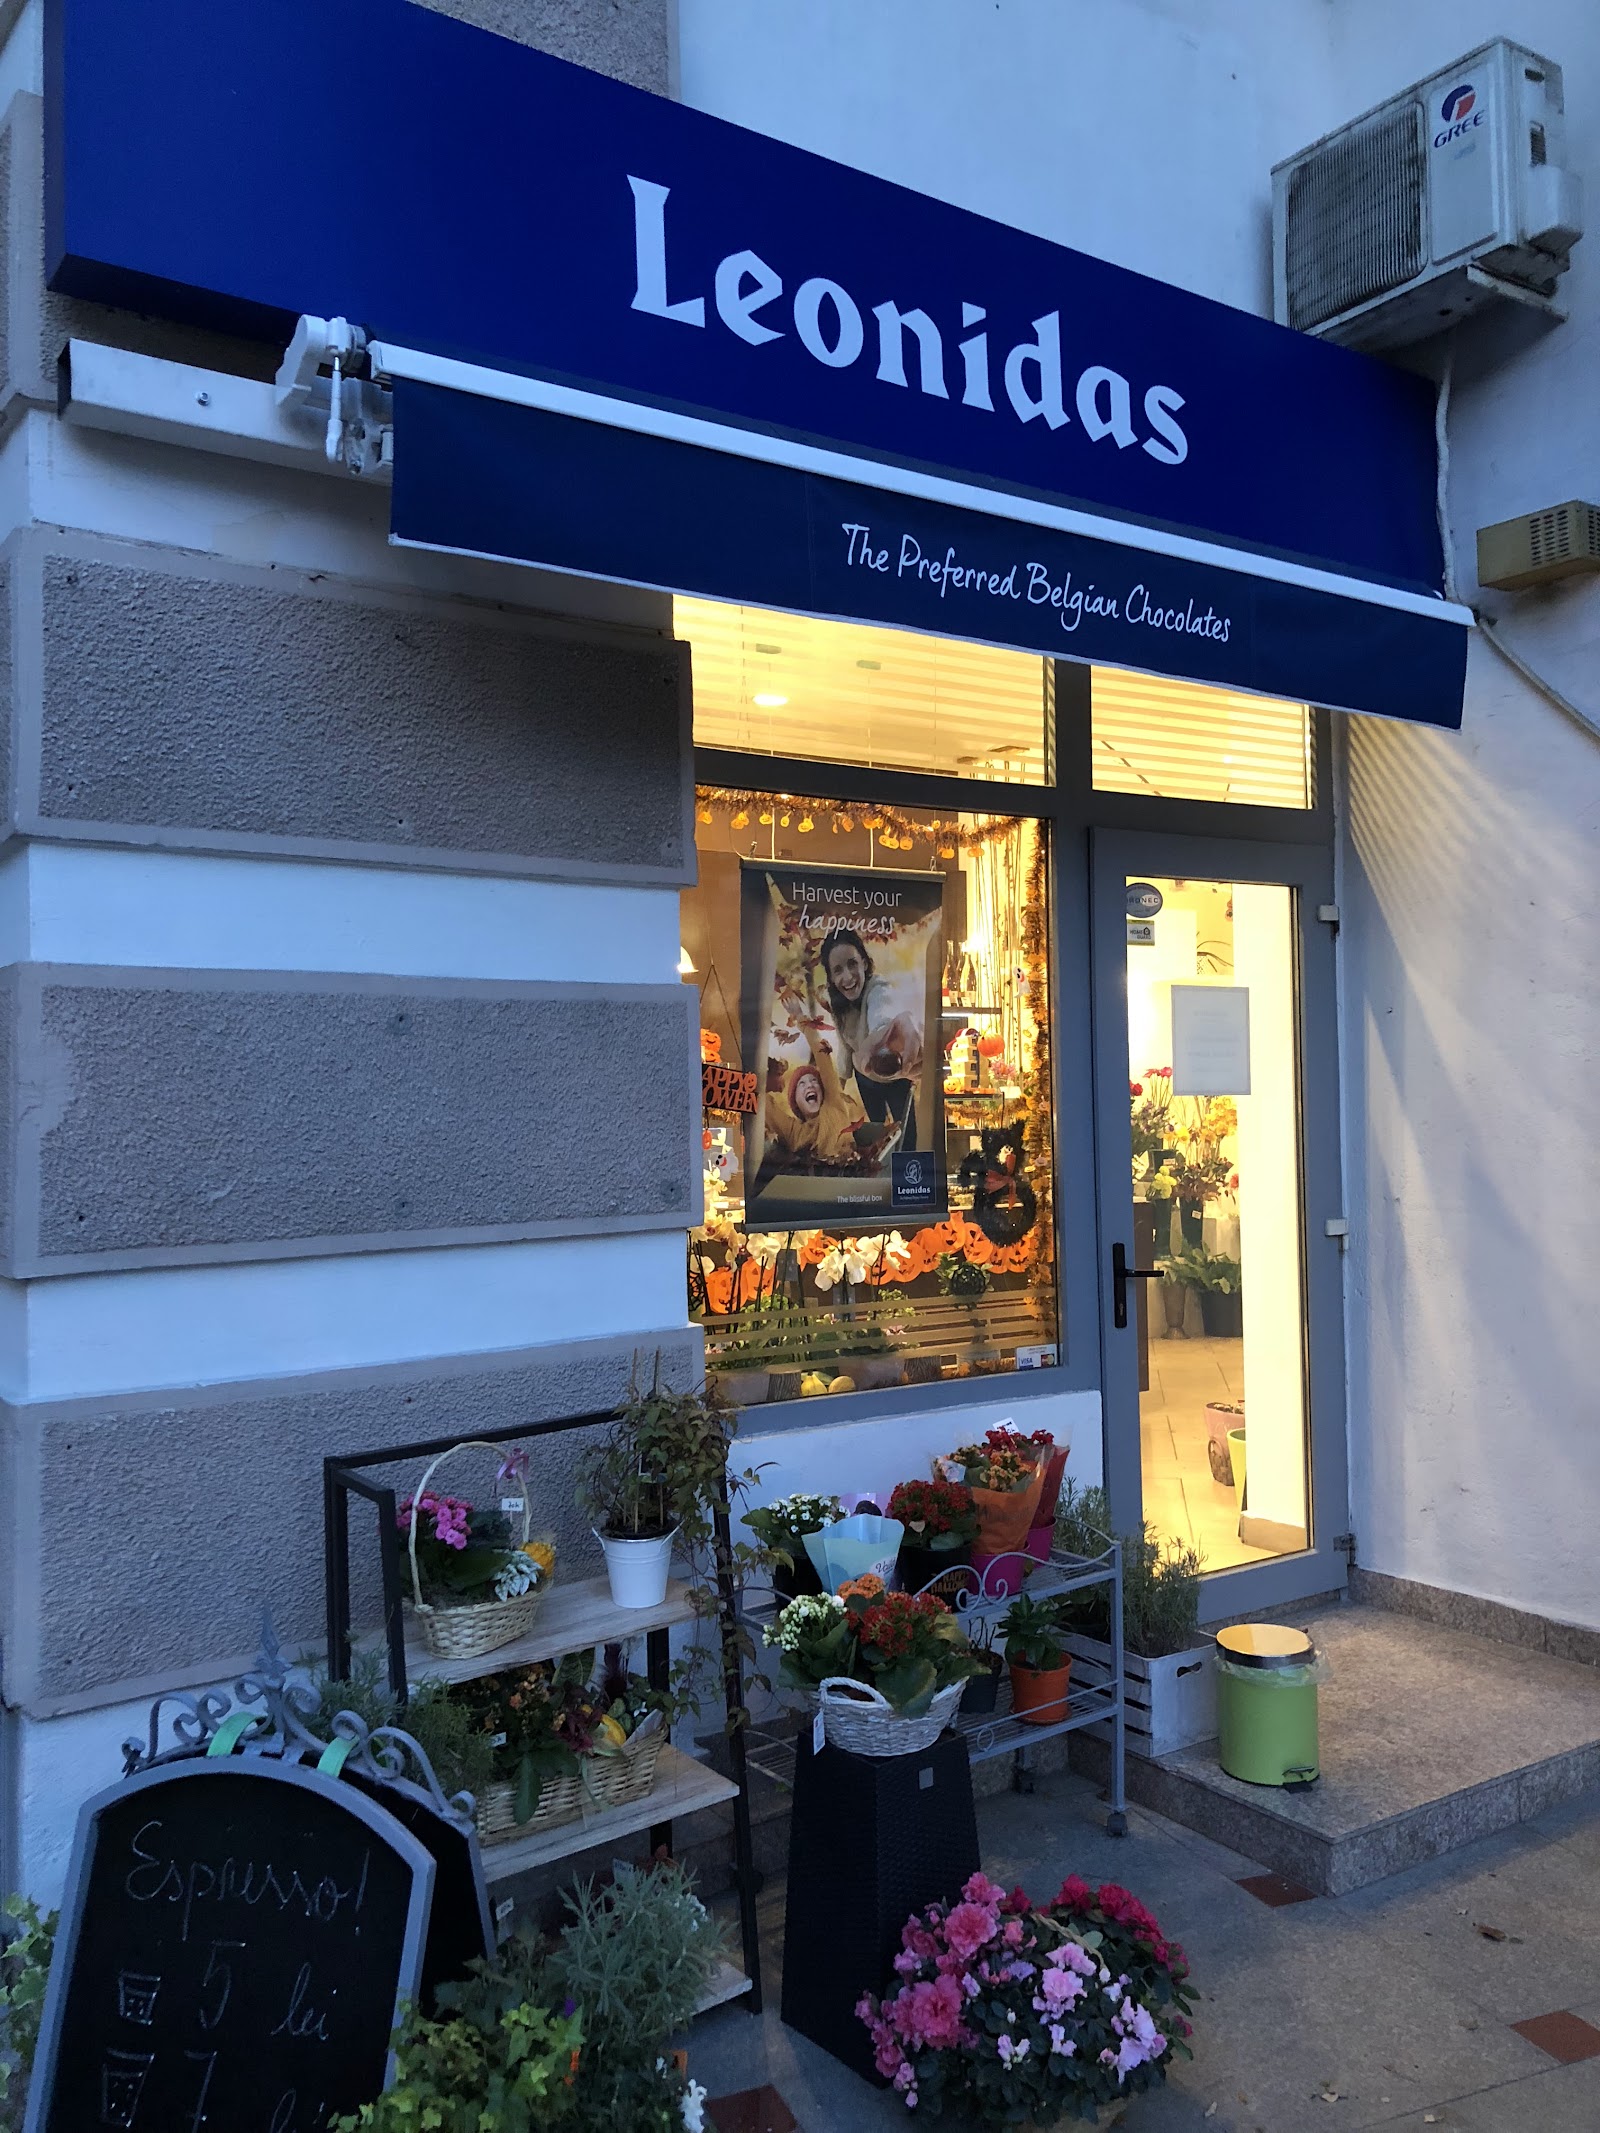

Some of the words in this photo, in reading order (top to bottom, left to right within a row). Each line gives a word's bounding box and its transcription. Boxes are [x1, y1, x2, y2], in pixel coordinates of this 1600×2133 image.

[1434, 110, 1486, 149] GREE
[626, 174, 1189, 465] Leonidas
[842, 522, 890, 573] The
[897, 533, 1021, 599] Preferred
[1026, 561, 1120, 632] Belgian
[1125, 584, 1232, 643] Chocolates
[792, 881, 860, 905] Harvest
[863, 890, 903, 910] your
[798, 903, 896, 940] happiness
[702, 1065, 748, 1092] APPY
[702, 1086, 759, 1114] OWEEN
[897, 1185, 931, 1195] Leonidas
[1021, 1357, 1033, 1365] VISA
[200, 1940, 246, 2030] 5
